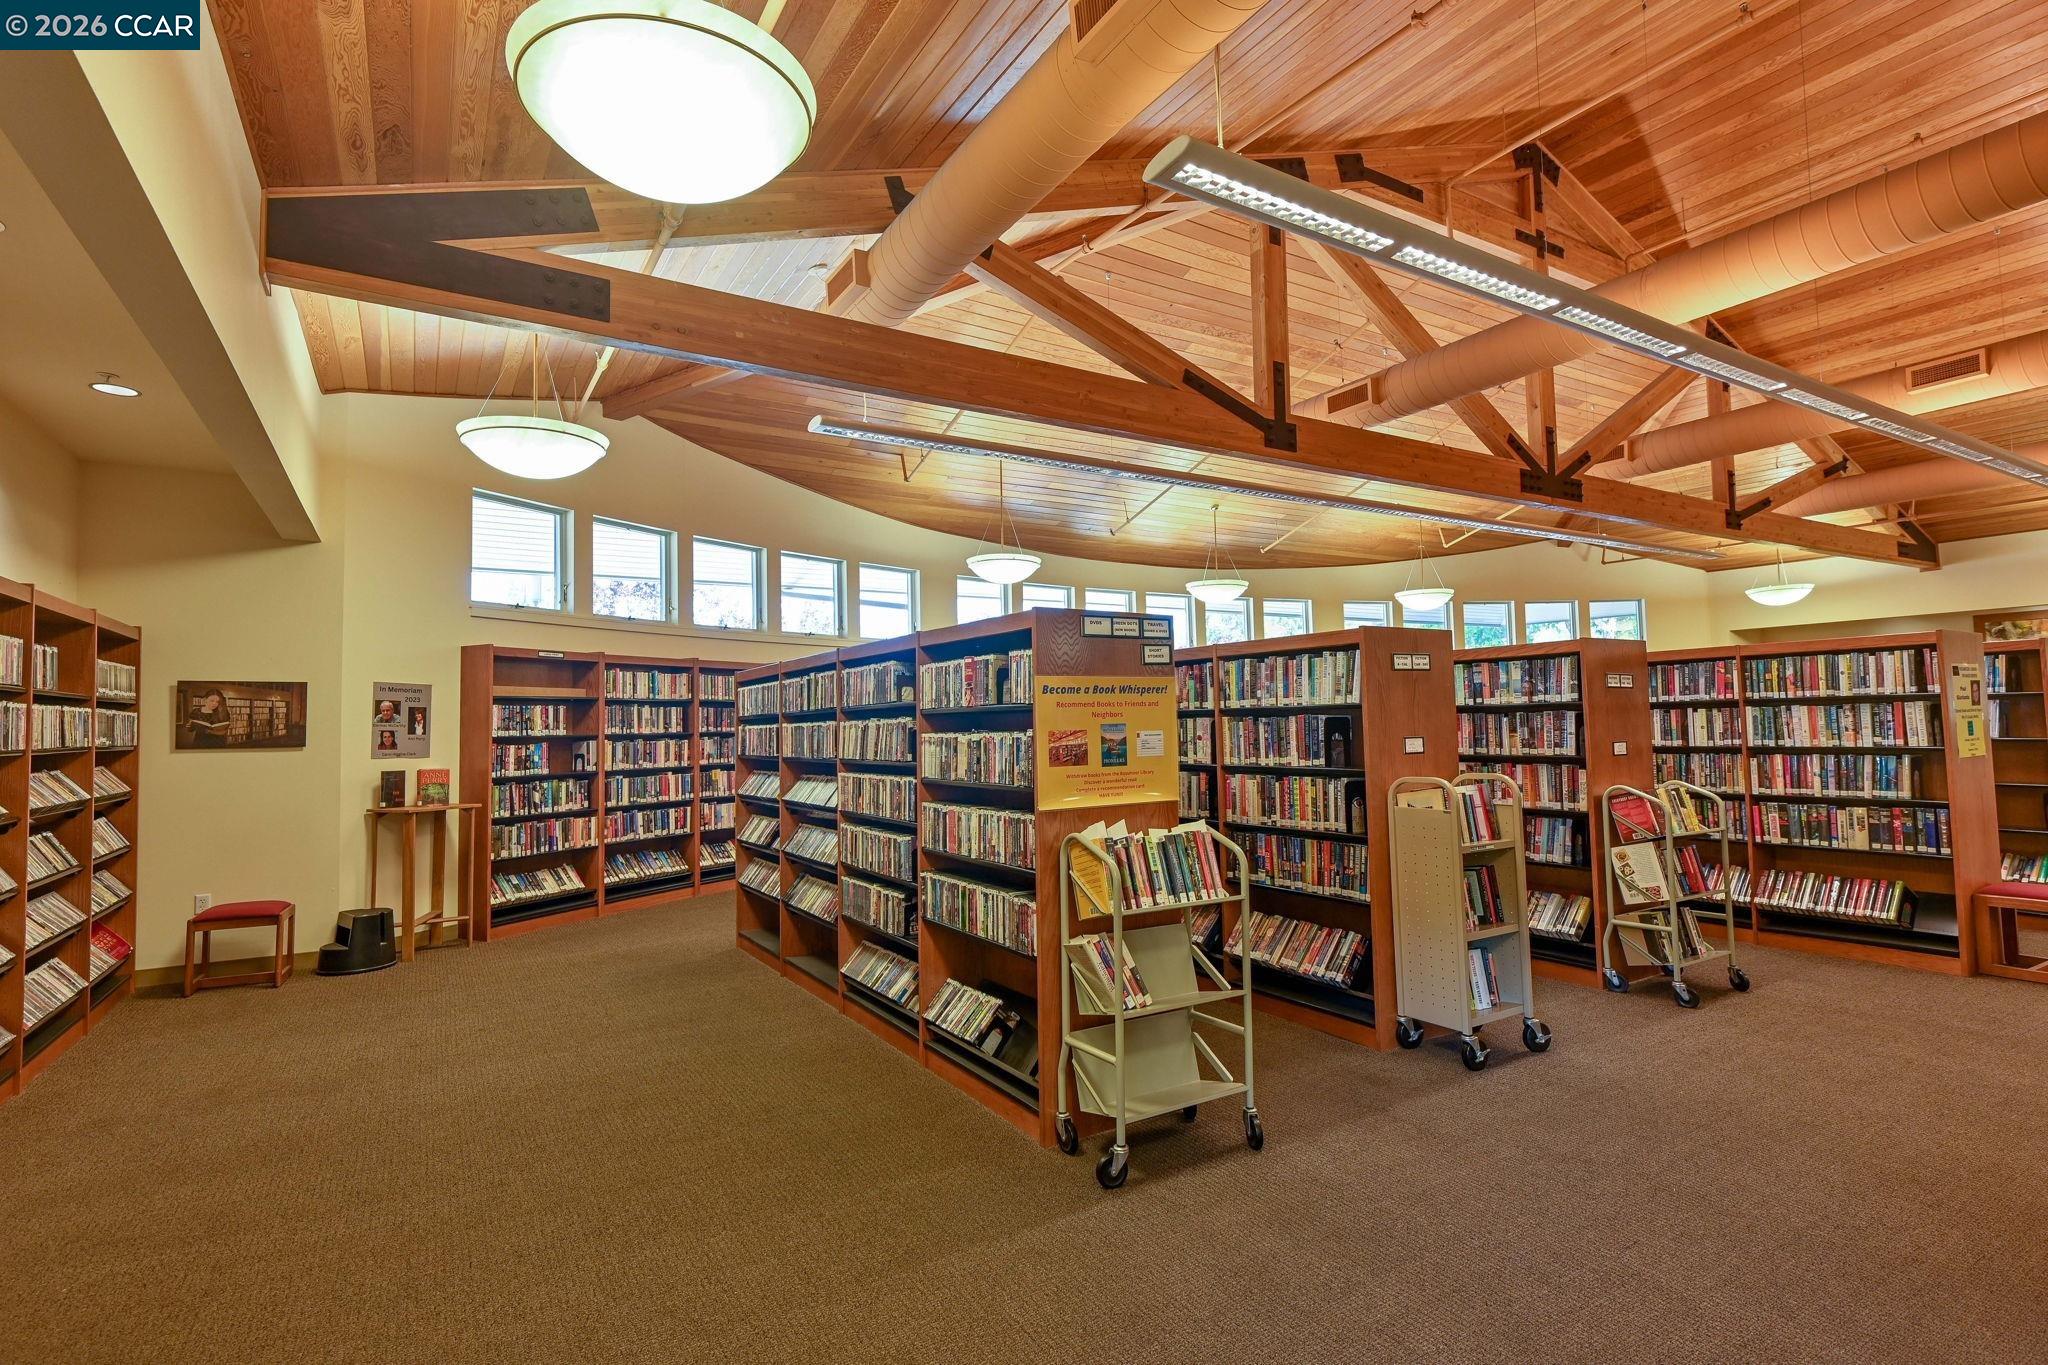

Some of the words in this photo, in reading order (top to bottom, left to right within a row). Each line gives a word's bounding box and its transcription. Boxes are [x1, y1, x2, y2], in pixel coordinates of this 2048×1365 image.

[387, 686, 423, 694] Memoriam
[1042, 684, 1081, 695] Become
[1083, 686, 1090, 694] a
[1092, 684, 1117, 694] Book
[1119, 684, 1169, 697] Whisperer!
[1096, 700, 1116, 708] Books
[1091, 711, 1124, 719] Neighbors
